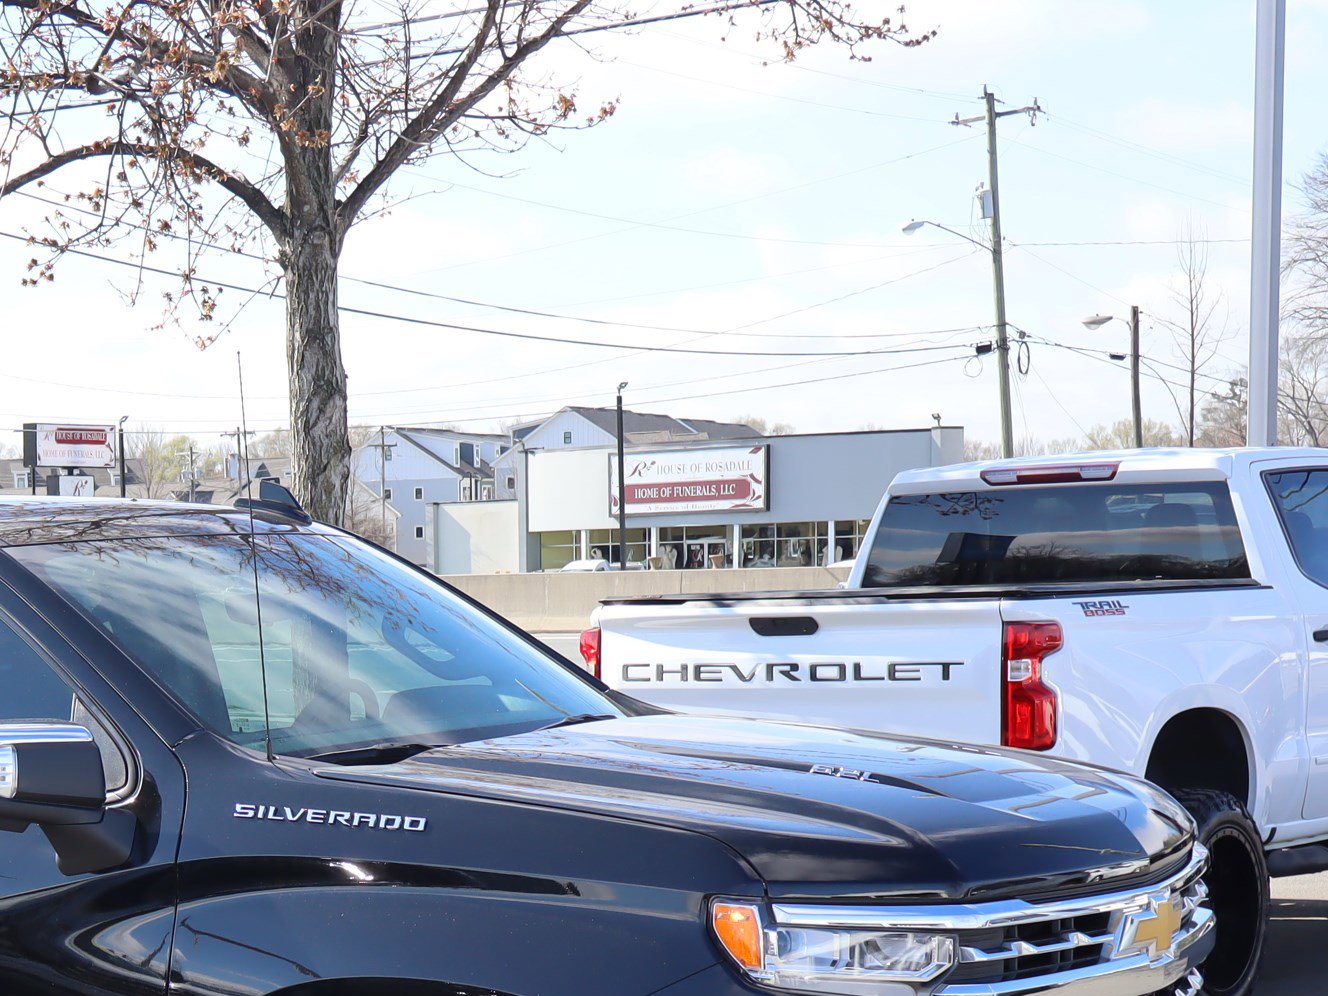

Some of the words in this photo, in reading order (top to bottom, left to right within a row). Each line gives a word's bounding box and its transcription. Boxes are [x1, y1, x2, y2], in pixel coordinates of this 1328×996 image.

[656, 463, 687, 476] HOUSE
[689, 462, 703, 474] OF
[705, 459, 753, 472] ROSADALE
[634, 486, 659, 499] HOME
[660, 486, 672, 498] OF
[673, 484, 719, 497] FUNERALS,
[720, 483, 736, 495] LLC
[1072, 600, 1129, 609] TRAIL
[1083, 608, 1126, 617] BOSS
[621, 662, 965, 682] CHEVROLET
[233, 803, 427, 831] SILVERADO
